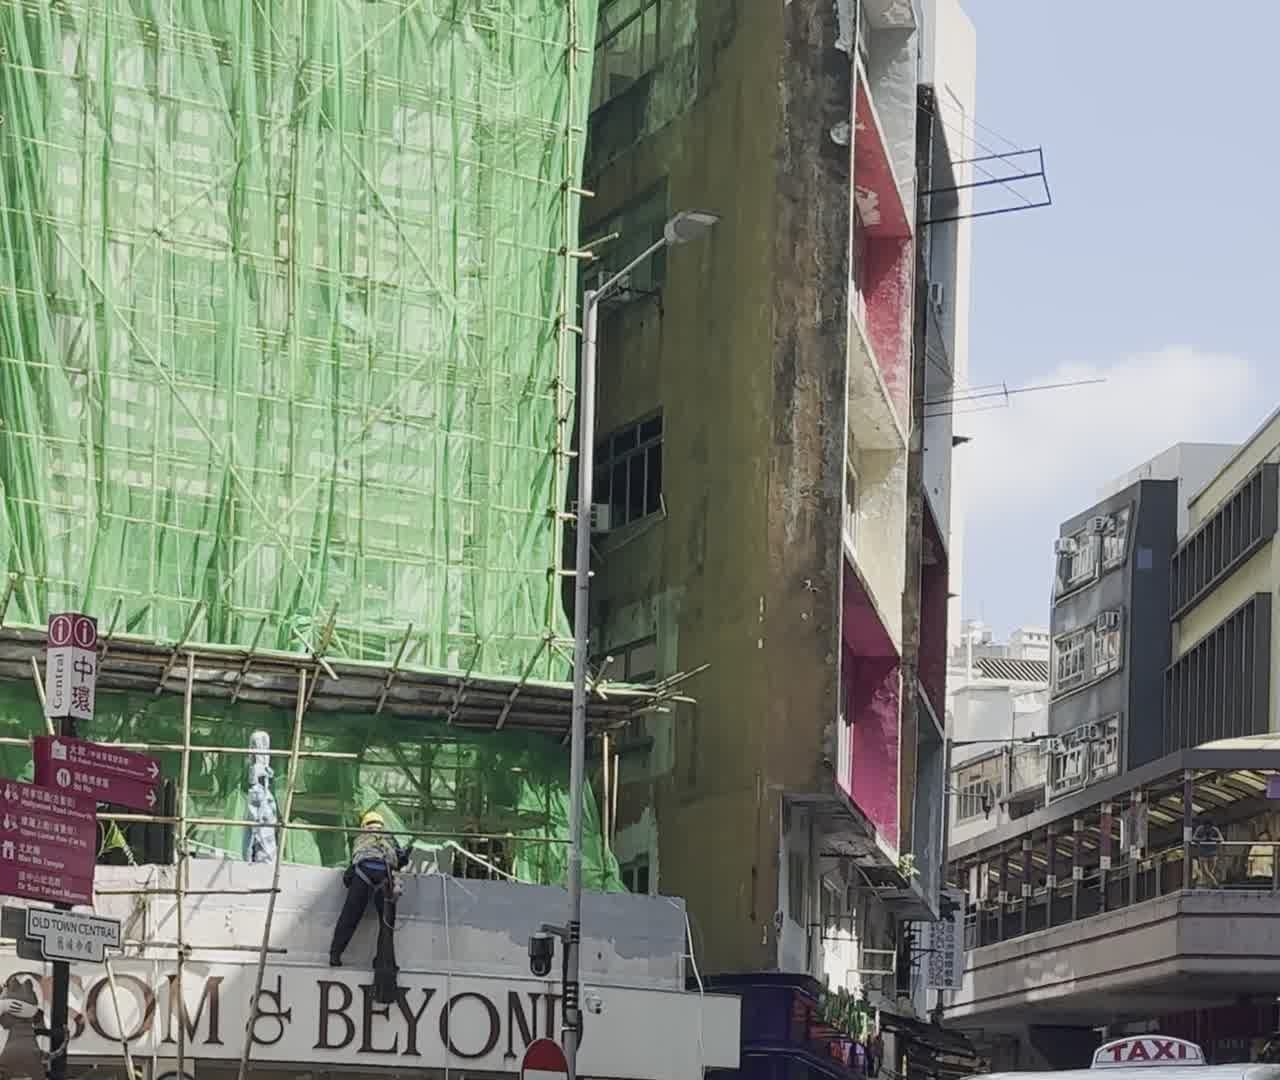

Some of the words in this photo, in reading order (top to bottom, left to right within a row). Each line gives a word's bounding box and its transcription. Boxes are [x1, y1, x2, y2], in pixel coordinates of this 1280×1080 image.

[53, 652, 64, 709] Central
[72, 655, 94, 713] 中環
[32, 916, 50, 929] OLD
[51, 919, 78, 934] TOWN
[79, 923, 117, 939] CENTRAL
[1107, 1039, 1187, 1062] TAXI
